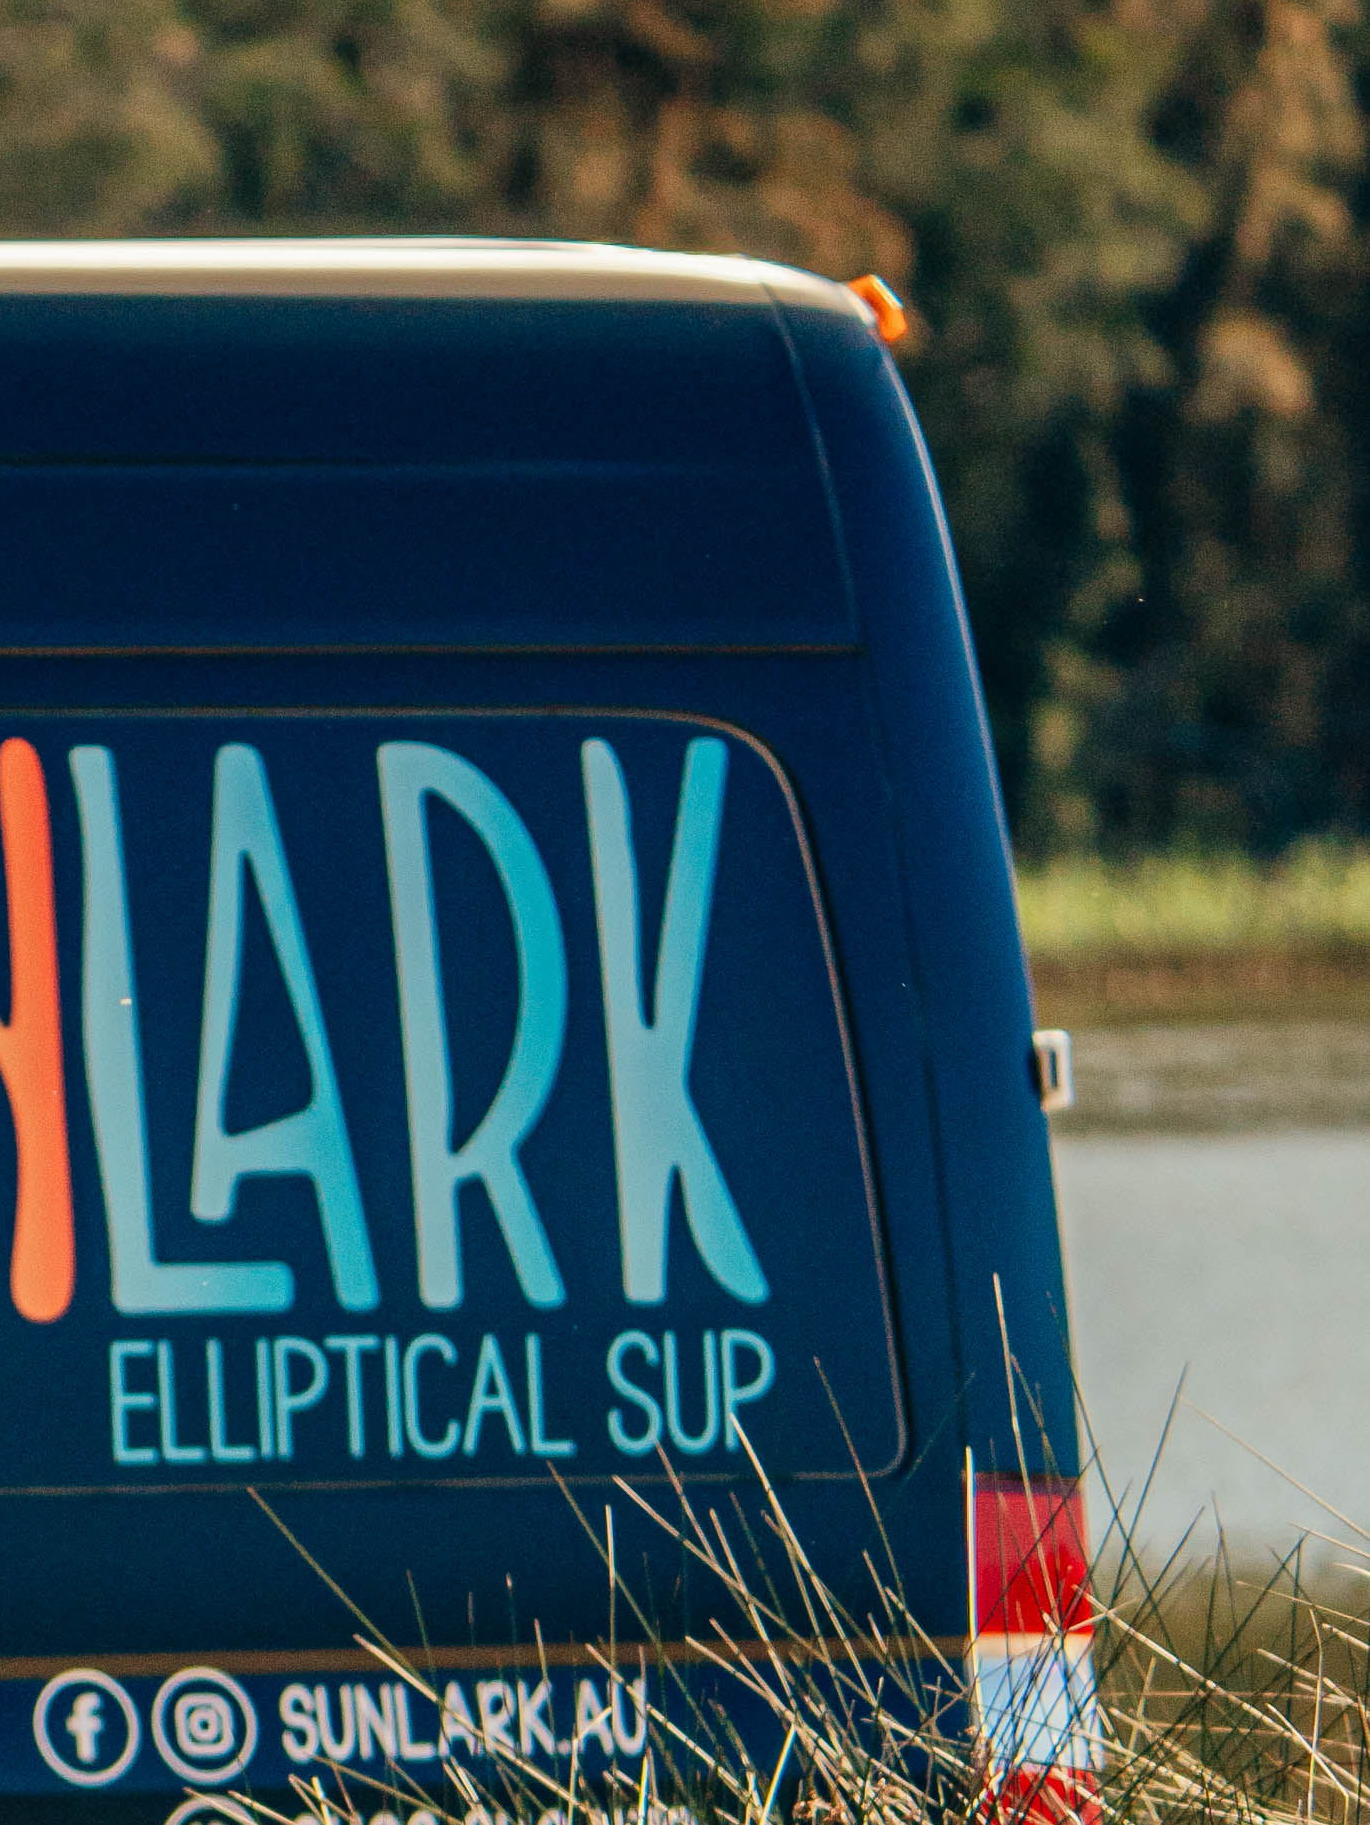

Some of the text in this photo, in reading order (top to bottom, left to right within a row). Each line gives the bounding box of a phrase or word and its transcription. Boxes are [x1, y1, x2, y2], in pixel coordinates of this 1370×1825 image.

[111, 1329, 776, 1464] ELLIPTICAL SUP
[279, 1678, 649, 1765] SUNLARK.AU
